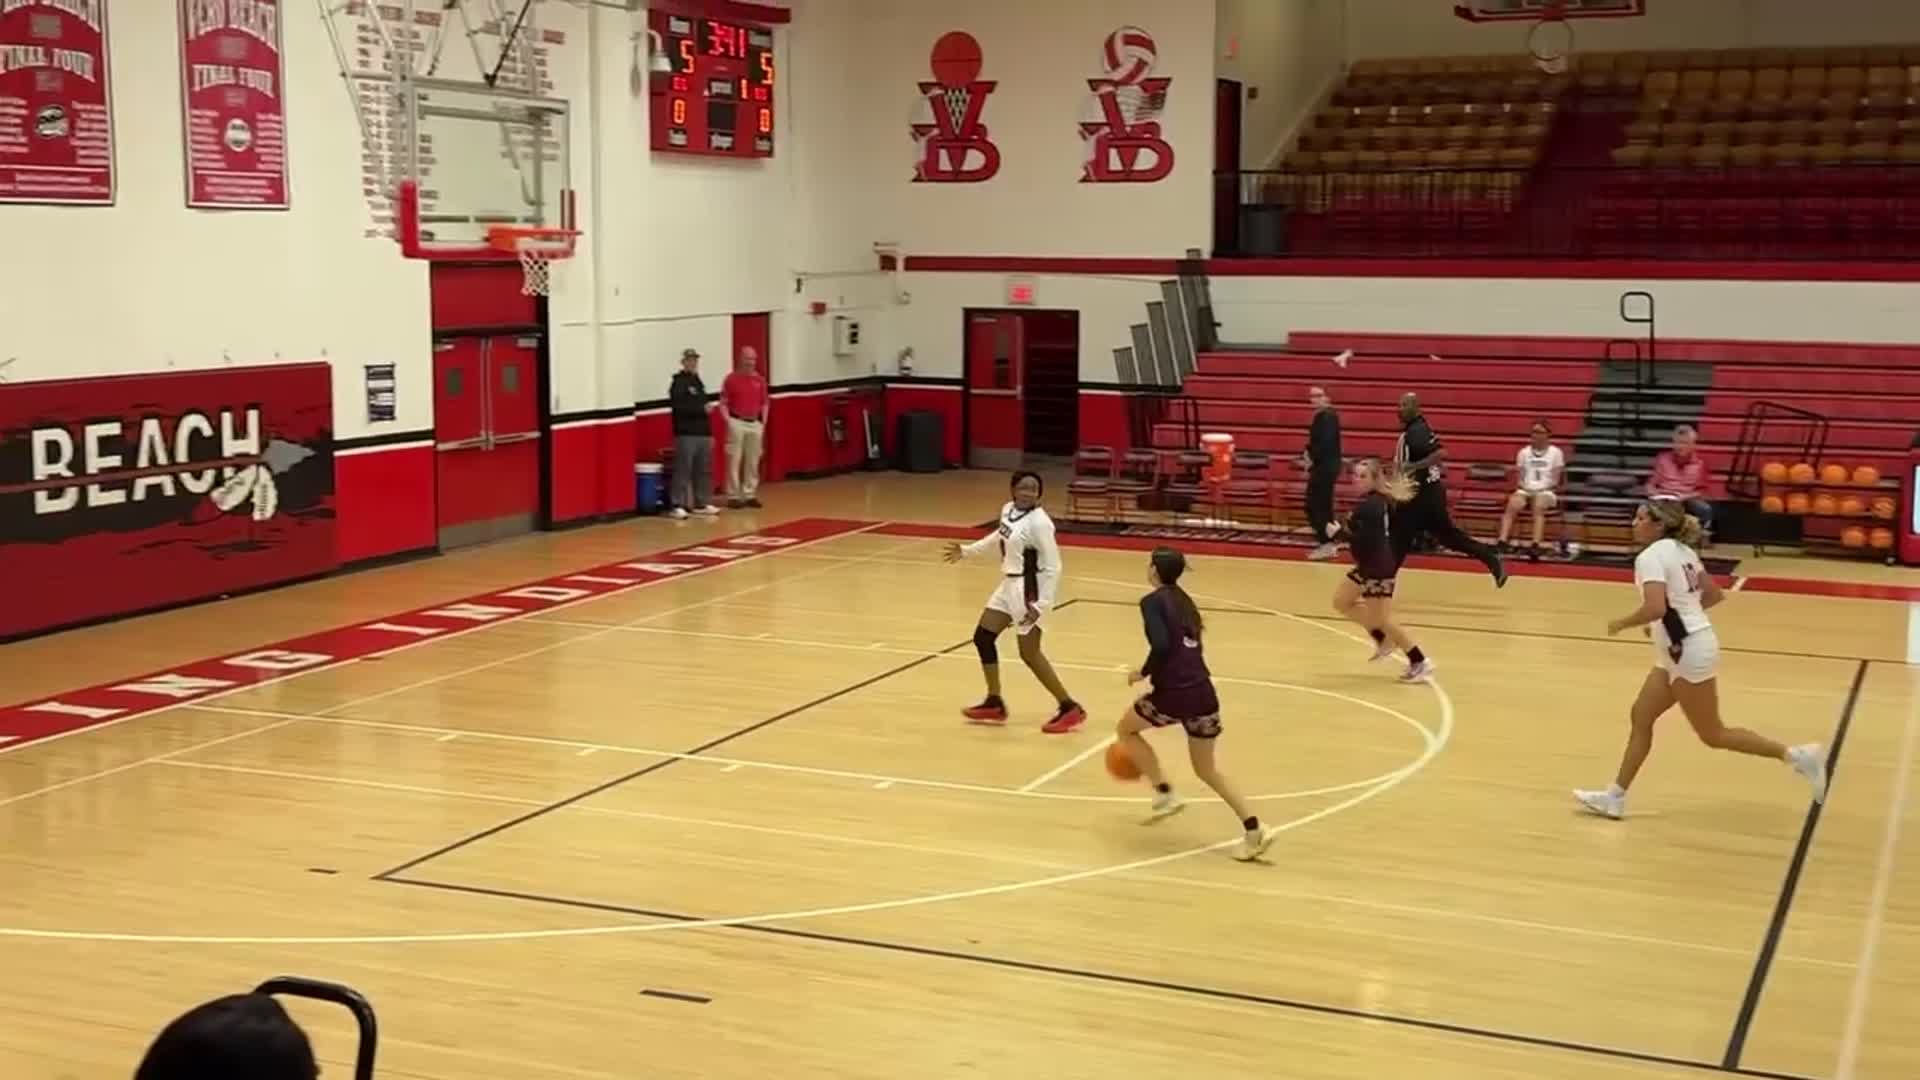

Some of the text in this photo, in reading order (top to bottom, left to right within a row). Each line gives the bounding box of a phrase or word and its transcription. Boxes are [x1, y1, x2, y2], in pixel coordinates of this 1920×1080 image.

[679, 39, 695, 74] 5
[759, 52, 773, 85] 5
[740, 79, 748, 99] 1
[673, 99, 686, 124] 0
[31, 407, 263, 516] BEACH
[0, 535, 799, 743] ING INDIANS
